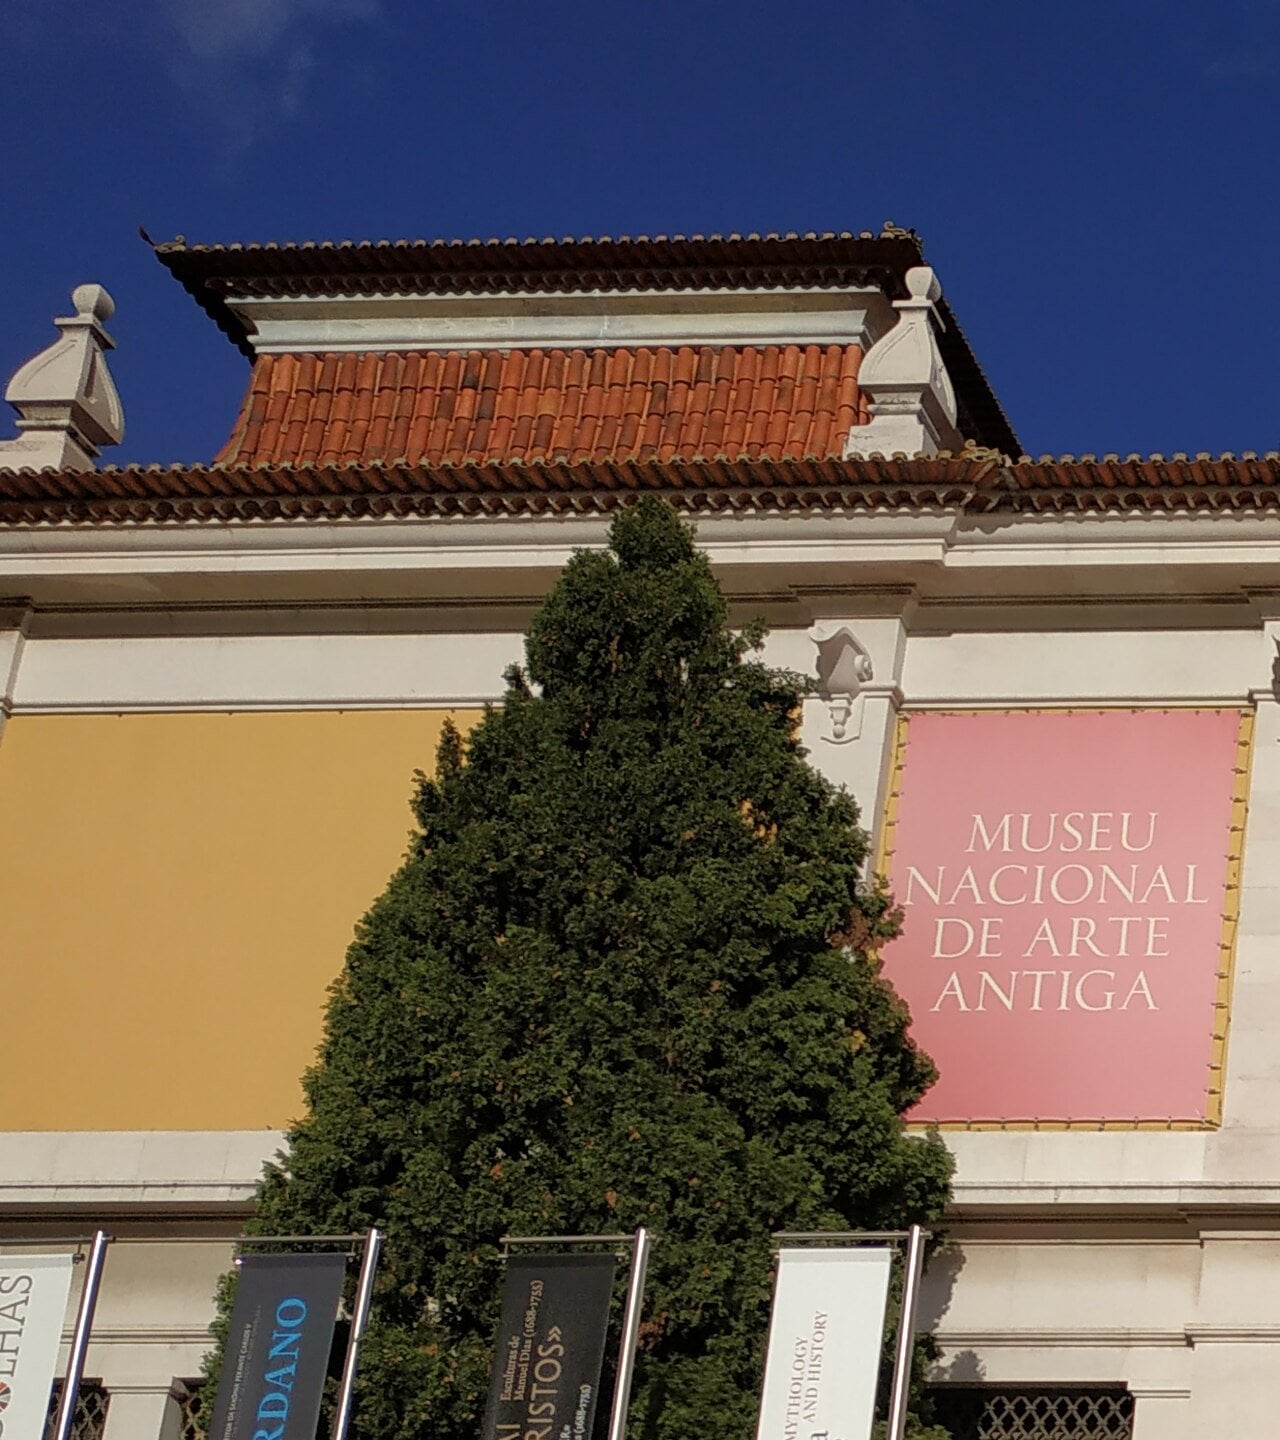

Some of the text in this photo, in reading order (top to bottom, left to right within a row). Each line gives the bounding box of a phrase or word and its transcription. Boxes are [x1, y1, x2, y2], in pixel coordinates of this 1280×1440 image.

[964, 812, 1159, 853] MUSEU
[904, 864, 1208, 907] NACIONAL
[931, 916, 1170, 958] DE ARTE
[930, 969, 1159, 1013] ANTIGA
[499, 1335, 521, 1401] Esculturas de
[519, 1339, 532, 1361] Dias
[802, 1310, 829, 1423] AND HISTORY
[513, 1363, 529, 1401] Manuel
